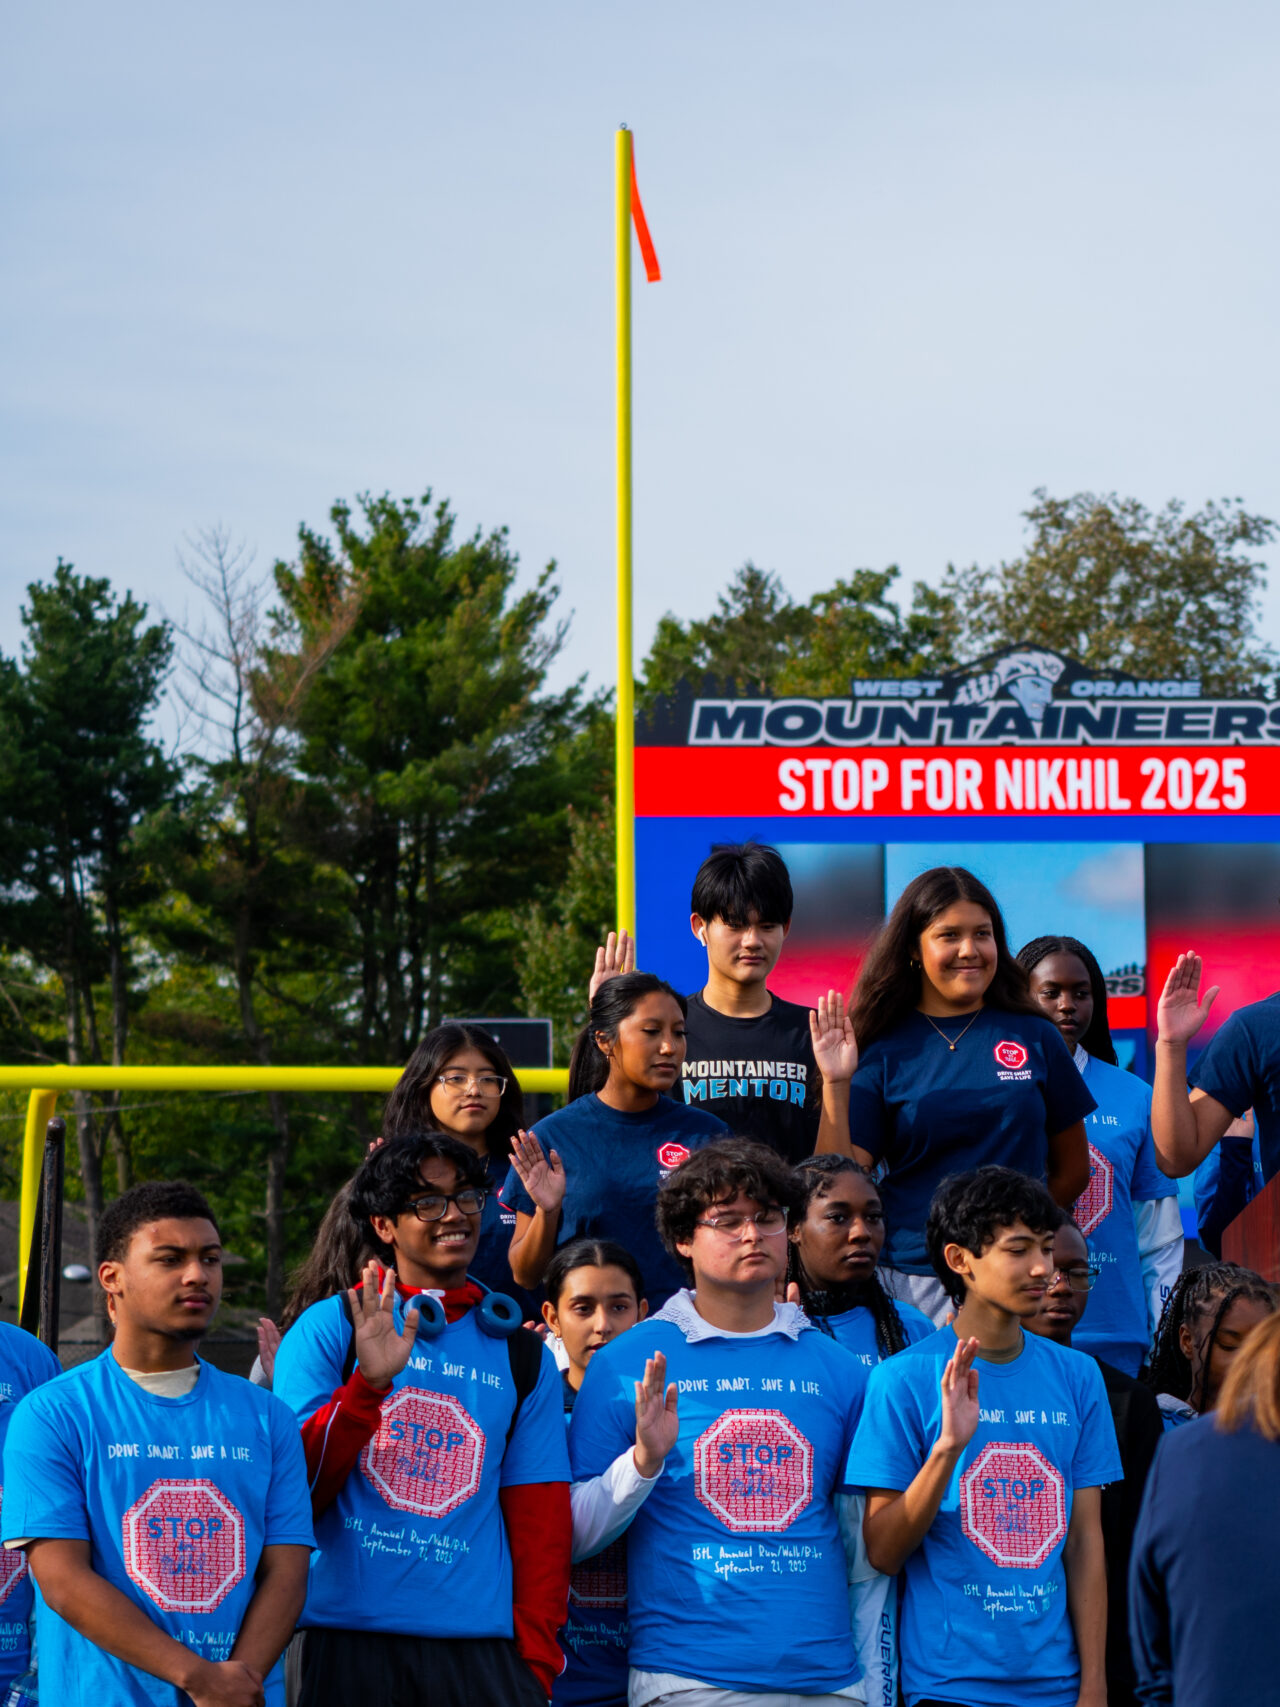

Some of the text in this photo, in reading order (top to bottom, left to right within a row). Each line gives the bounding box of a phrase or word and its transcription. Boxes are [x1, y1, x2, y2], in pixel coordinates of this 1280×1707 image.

[853, 680, 1201, 697] WEST ORANGE
[778, 757, 1247, 811] STOP FOR NIKHIL 2025
[682, 1060, 807, 1081] MOUNTAINEER
[683, 1078, 806, 1109] MENTOR
[1102, 1115, 1121, 1127] LIFE.
[442, 1362, 466, 1379] SAVE
[471, 1368, 478, 1381] A
[482, 1371, 504, 1390] LIFE.
[678, 1377, 823, 1396] DRIVE SMART. SAVE A LIFE.
[979, 1409, 1070, 1426] SMART. SAVE A LIFE.
[389, 1420, 465, 1452] STOP
[108, 1443, 253, 1462] DRIVE SMART. SAVE A LIFE.
[719, 1443, 793, 1465] STOP
[983, 1478, 1045, 1500] STOP
[147, 1517, 223, 1539] STOP
[344, 1517, 364, 1531] 15th
[370, 1522, 405, 1540] Annual
[361, 1535, 412, 1558] September
[435, 1548, 454, 1564] 2025
[693, 1546, 713, 1560] 15th
[720, 1545, 752, 1559] Annual
[714, 1560, 764, 1581] September
[788, 1560, 807, 1573] 2025
[963, 1584, 981, 1597] 15th
[986, 1584, 1015, 1598] Annual
[983, 1599, 1023, 1621] September
[880, 1612, 892, 1707] GUERRA
